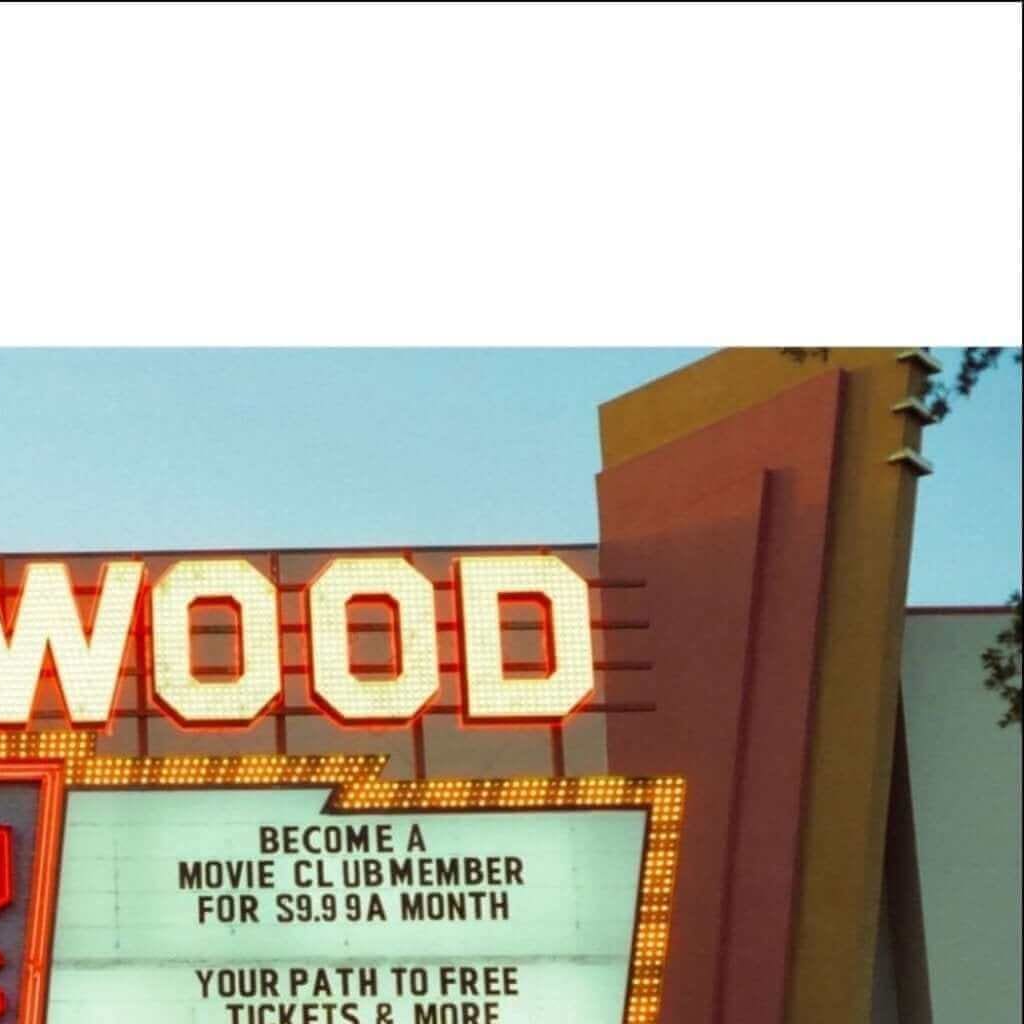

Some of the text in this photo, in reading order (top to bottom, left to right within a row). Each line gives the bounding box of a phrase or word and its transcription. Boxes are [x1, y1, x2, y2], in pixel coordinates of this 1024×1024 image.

[259, 823, 426, 854] BECOME A
[179, 860, 275, 889] MOVIE
[198, 895, 259, 924] FOR
[400, 891, 509, 921] MONTH
[195, 966, 518, 998] YOUR PATH TO FREE
